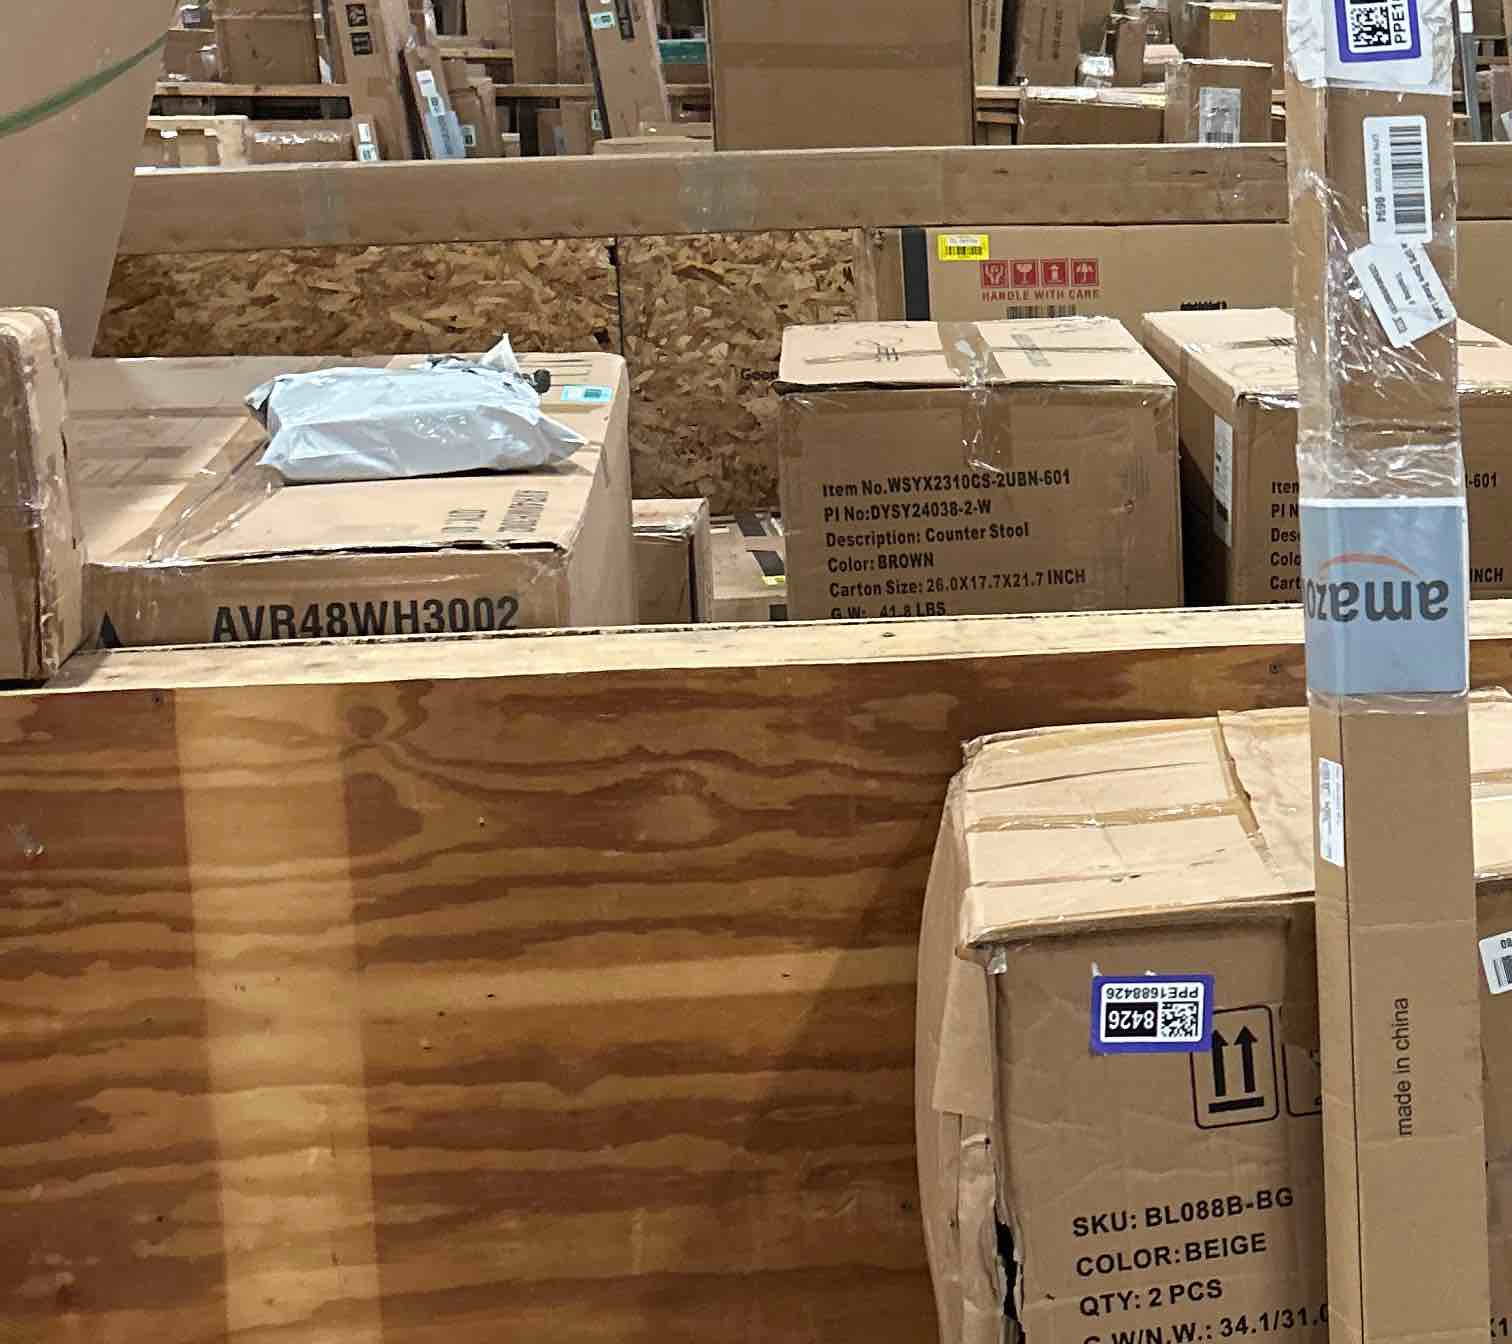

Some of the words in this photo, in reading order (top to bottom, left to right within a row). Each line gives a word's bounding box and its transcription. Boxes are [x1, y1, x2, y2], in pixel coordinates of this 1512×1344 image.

[982, 288, 1029, 301] HANDLE
[1034, 288, 1065, 300] WITH
[1069, 287, 1100, 299] CARE
[823, 483, 858, 497] Item
[826, 529, 921, 549] Description:
[926, 525, 986, 544] Counter
[990, 522, 1029, 539] Stool
[828, 557, 874, 573] Color:
[878, 552, 934, 569] BROWN
[830, 581, 881, 598] Carton
[885, 579, 923, 595] Size:
[926, 572, 1043, 594] 26.0X17.7X21.7
[1048, 569, 1085, 585] INCH
[212, 595, 520, 643] AVR48WH3002
[916, 602, 946, 616] LBS
[1106, 987, 1199, 999] PPE1688426
[1108, 1010, 1155, 1029] 8426
[1391, 997, 1409, 1054] china
[1393, 1057, 1410, 1074] in
[1396, 1076, 1412, 1136] made
[1072, 1211, 1137, 1237] SKU:
[1145, 1187, 1293, 1227] BL088B-BG
[1080, 1290, 1141, 1317] QTY:
[1149, 1288, 1162, 1307] 2
[1170, 1279, 1223, 1304] PCS
